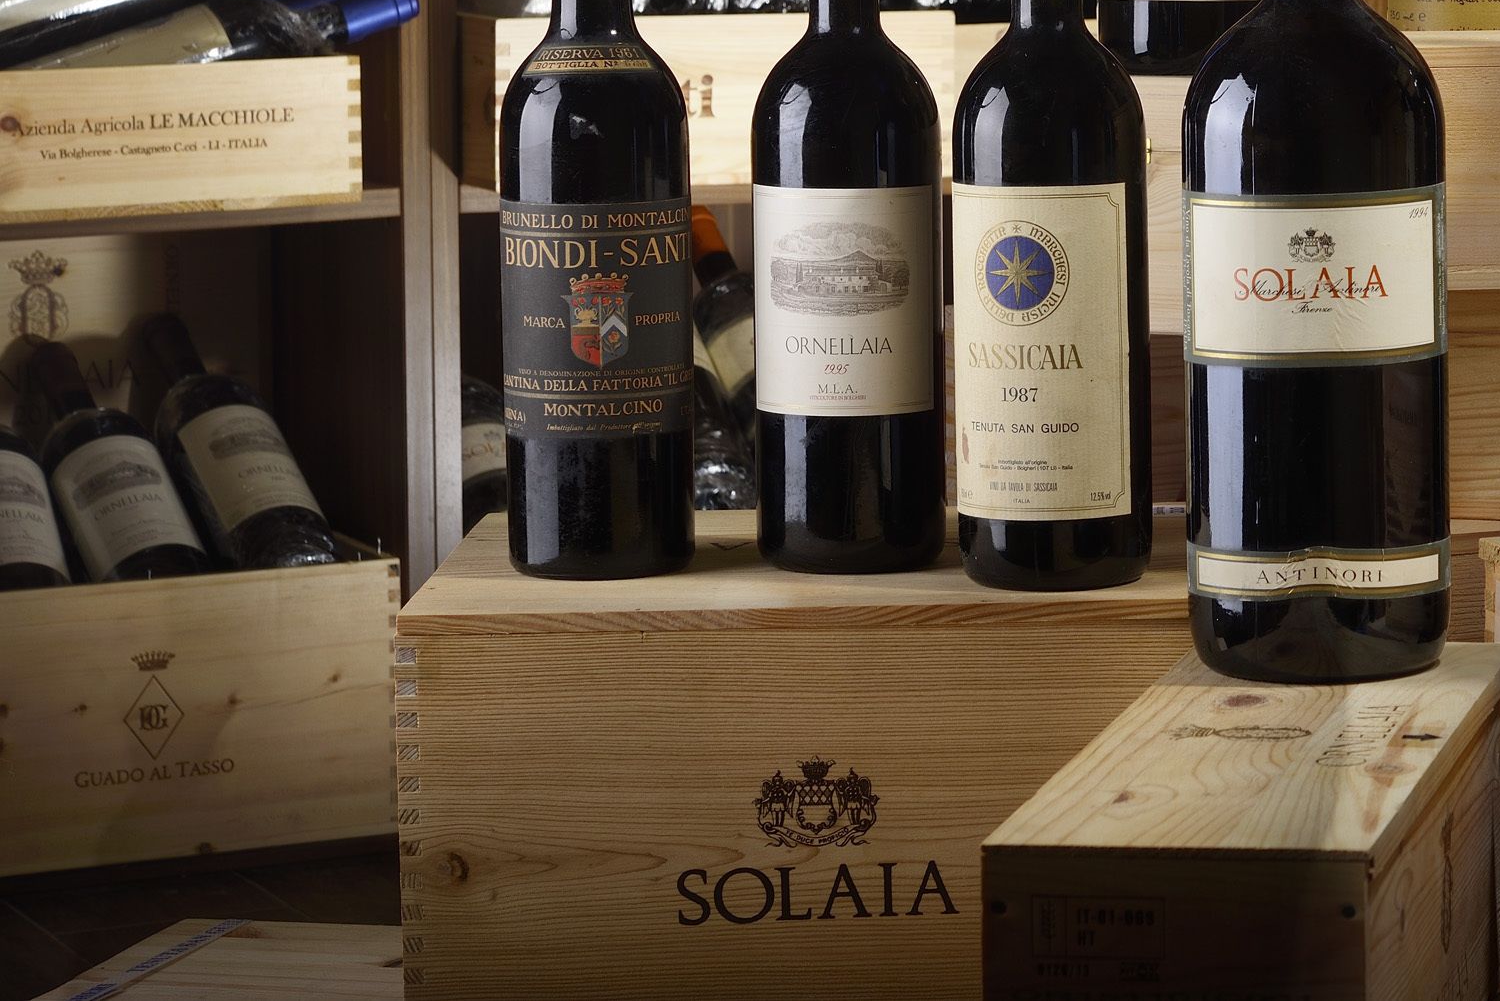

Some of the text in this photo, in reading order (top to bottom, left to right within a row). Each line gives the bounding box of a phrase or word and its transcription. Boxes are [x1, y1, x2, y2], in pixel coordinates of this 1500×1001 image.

[538, 48, 605, 61] RISERVA
[534, 60, 600, 70] BOTTIGLIA
[12, 107, 295, 138] Azienda Agricola LE MACCHIOLE
[40, 149, 57, 161] Via
[59, 147, 112, 160] Bolgherese
[120, 143, 172, 157] Castagneto
[228, 138, 268, 150] ITALIA
[502, 209, 573, 230] BRUNELLO
[581, 214, 599, 229] DI
[1408, 206, 1429, 219] 1994
[1233, 264, 1389, 302] SOLAIA
[1291, 300, 1333, 314] Firenze
[523, 311, 681, 329] MARCA PROPRIA
[785, 335, 893, 356] ORNELLAIA
[968, 341, 1083, 371] SASSICAIA
[539, 369, 601, 378] DENOMINAZIONE
[603, 369, 613, 377] DI
[824, 363, 850, 375] 1995
[544, 377, 588, 392] DELLA
[593, 375, 663, 391] FATTORIA
[818, 383, 859, 394] M.L.A.
[1000, 386, 1039, 403] 1987
[543, 398, 663, 417] MONTALCINO
[971, 421, 1080, 434] TENUTA SAN GUIDO
[1256, 566, 1384, 585] ANTINORI
[74, 758, 235, 789] GUADO AL TASSO
[676, 859, 961, 926] SOLAIA
